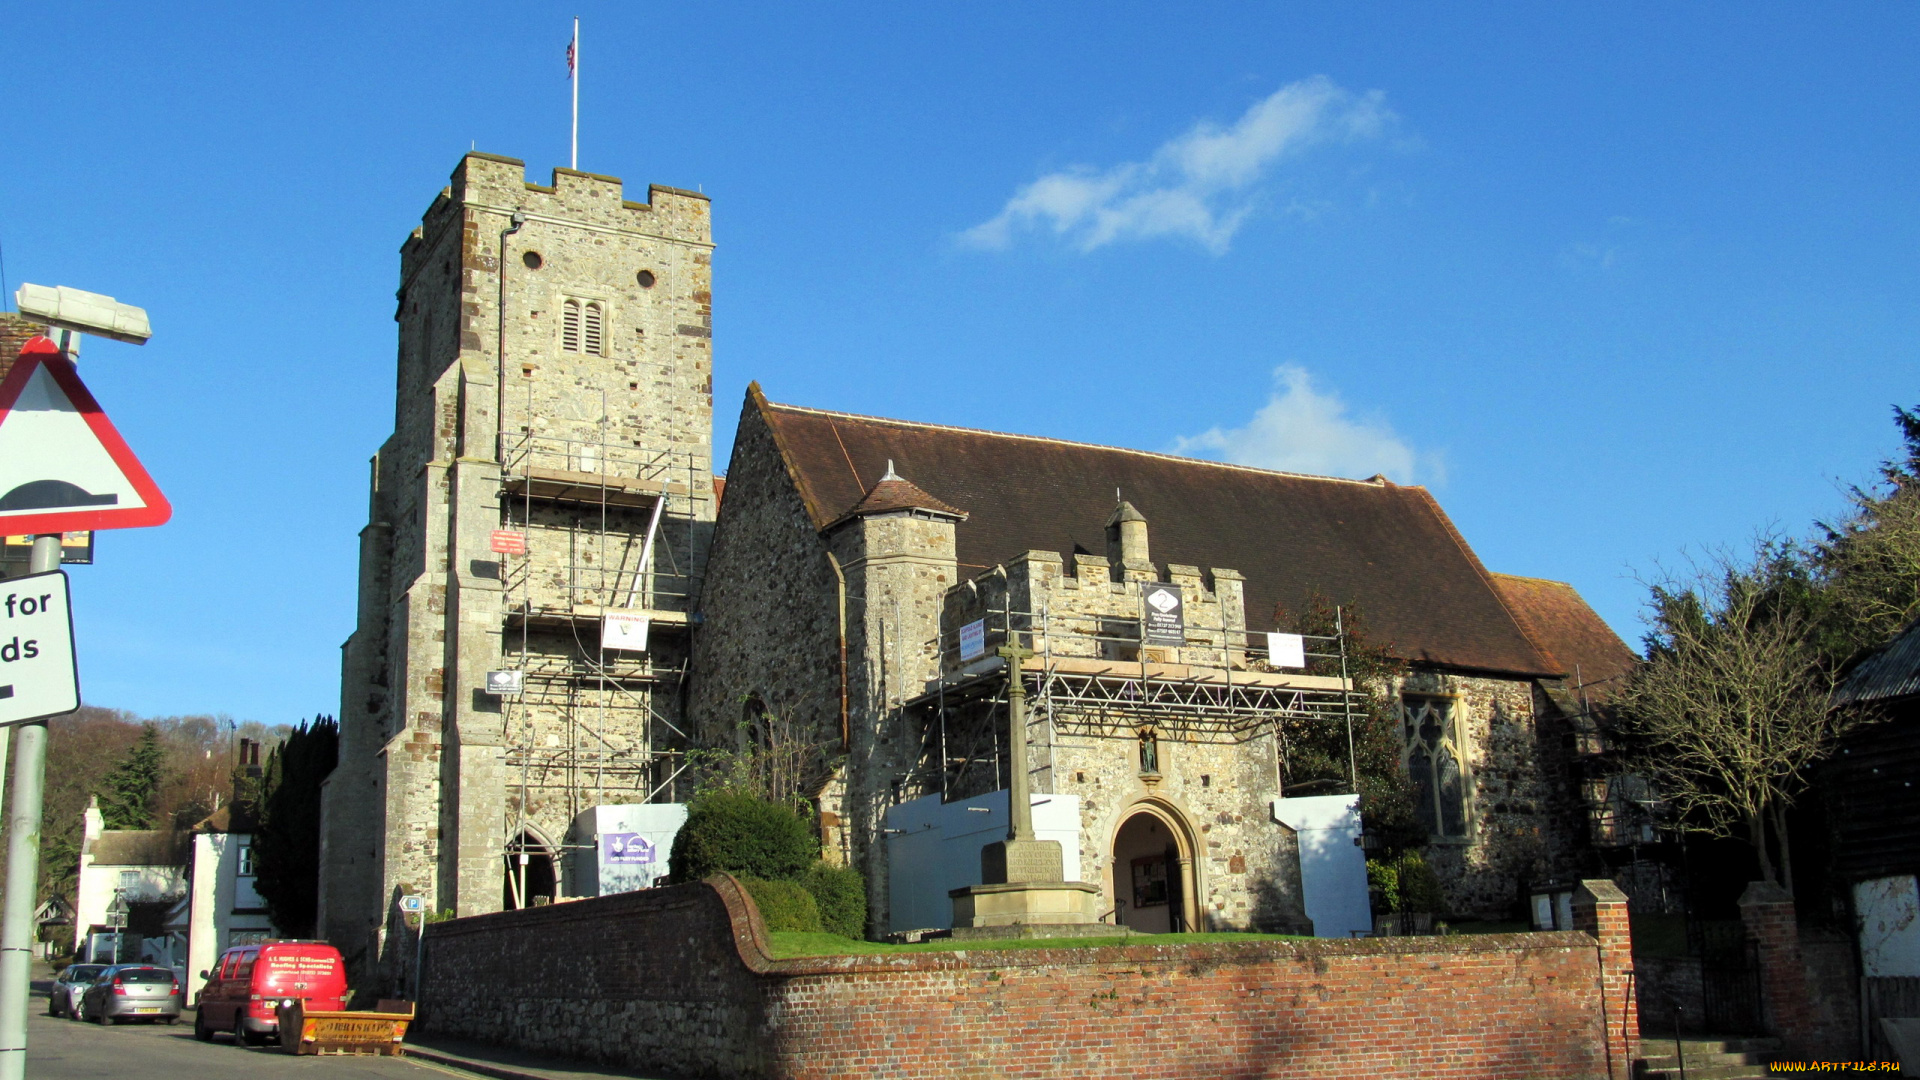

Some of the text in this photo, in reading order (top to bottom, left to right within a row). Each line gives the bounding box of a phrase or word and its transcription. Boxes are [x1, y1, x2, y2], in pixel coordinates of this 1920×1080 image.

[5, 593, 51, 618] for
[1158, 593, 1168, 608] 2
[608, 614, 647, 622] WARNING!
[1, 636, 39, 662] ds
[411, 899, 417, 908] P
